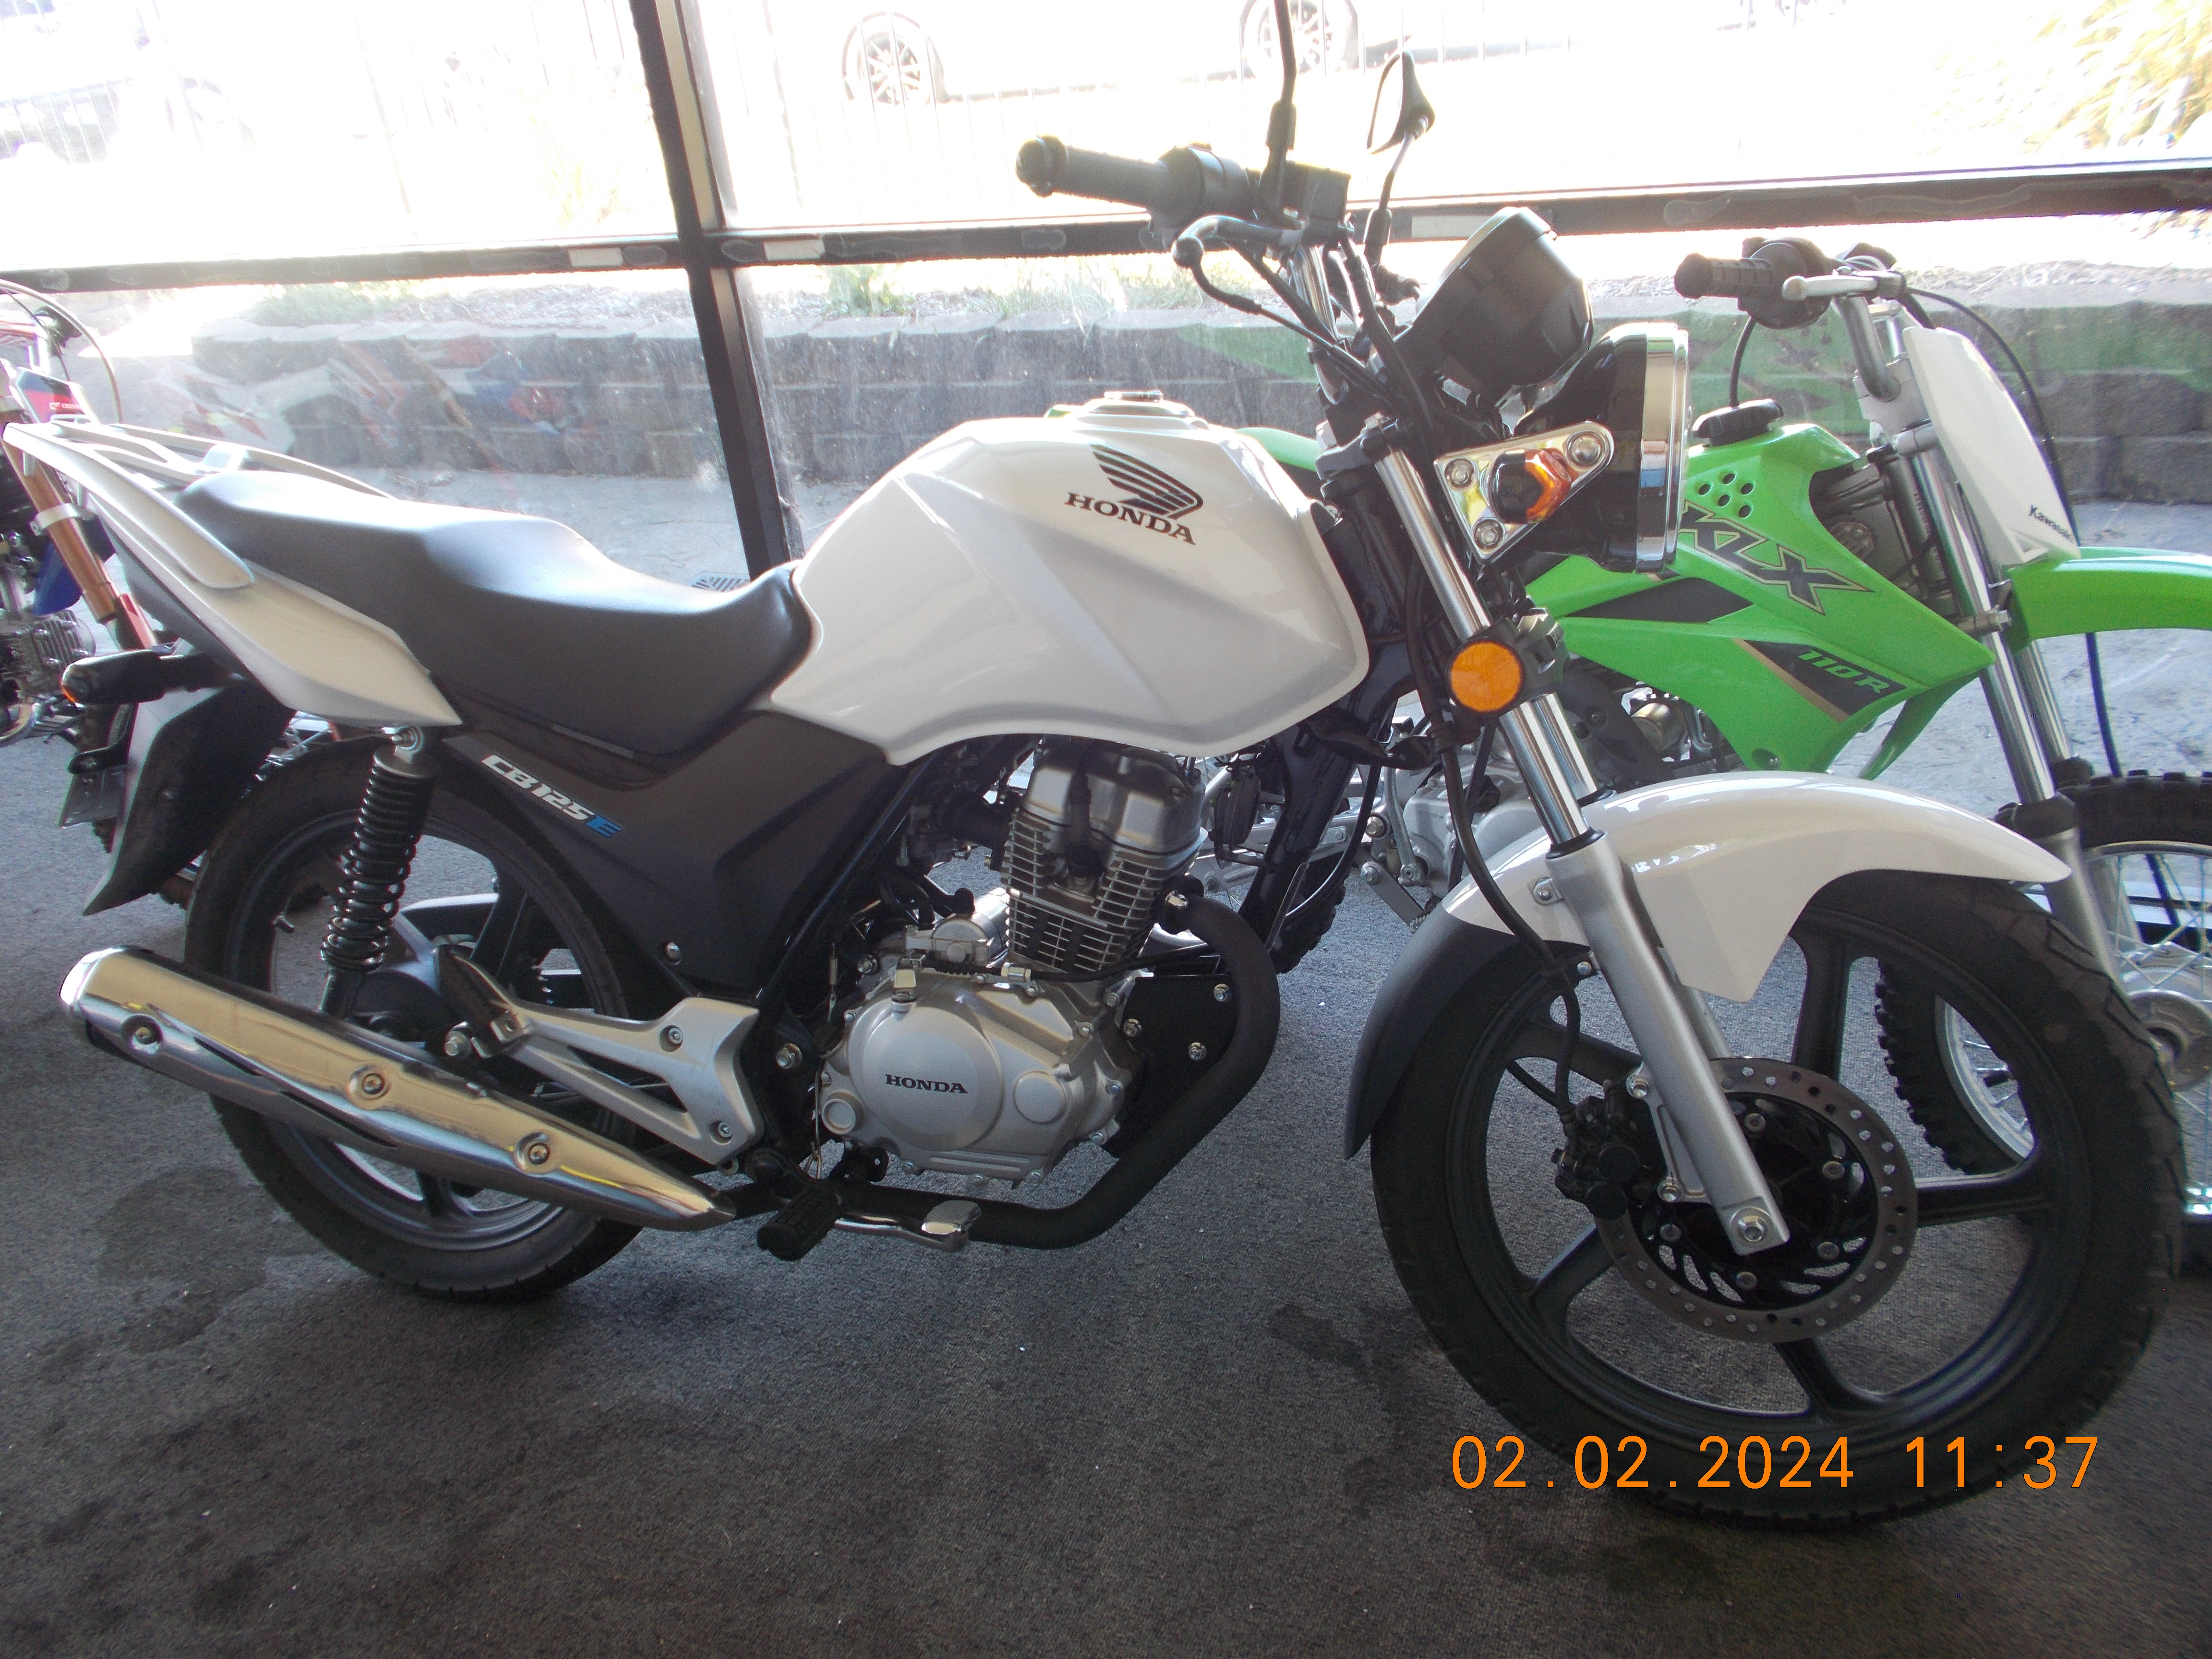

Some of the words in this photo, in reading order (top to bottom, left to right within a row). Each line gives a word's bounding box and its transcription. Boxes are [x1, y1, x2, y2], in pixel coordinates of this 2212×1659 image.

[1064, 492, 1196, 546] HONDA
[1798, 650, 1890, 694] 110R
[481, 754, 623, 838] CB125E
[885, 1074, 968, 1094] HONDA
